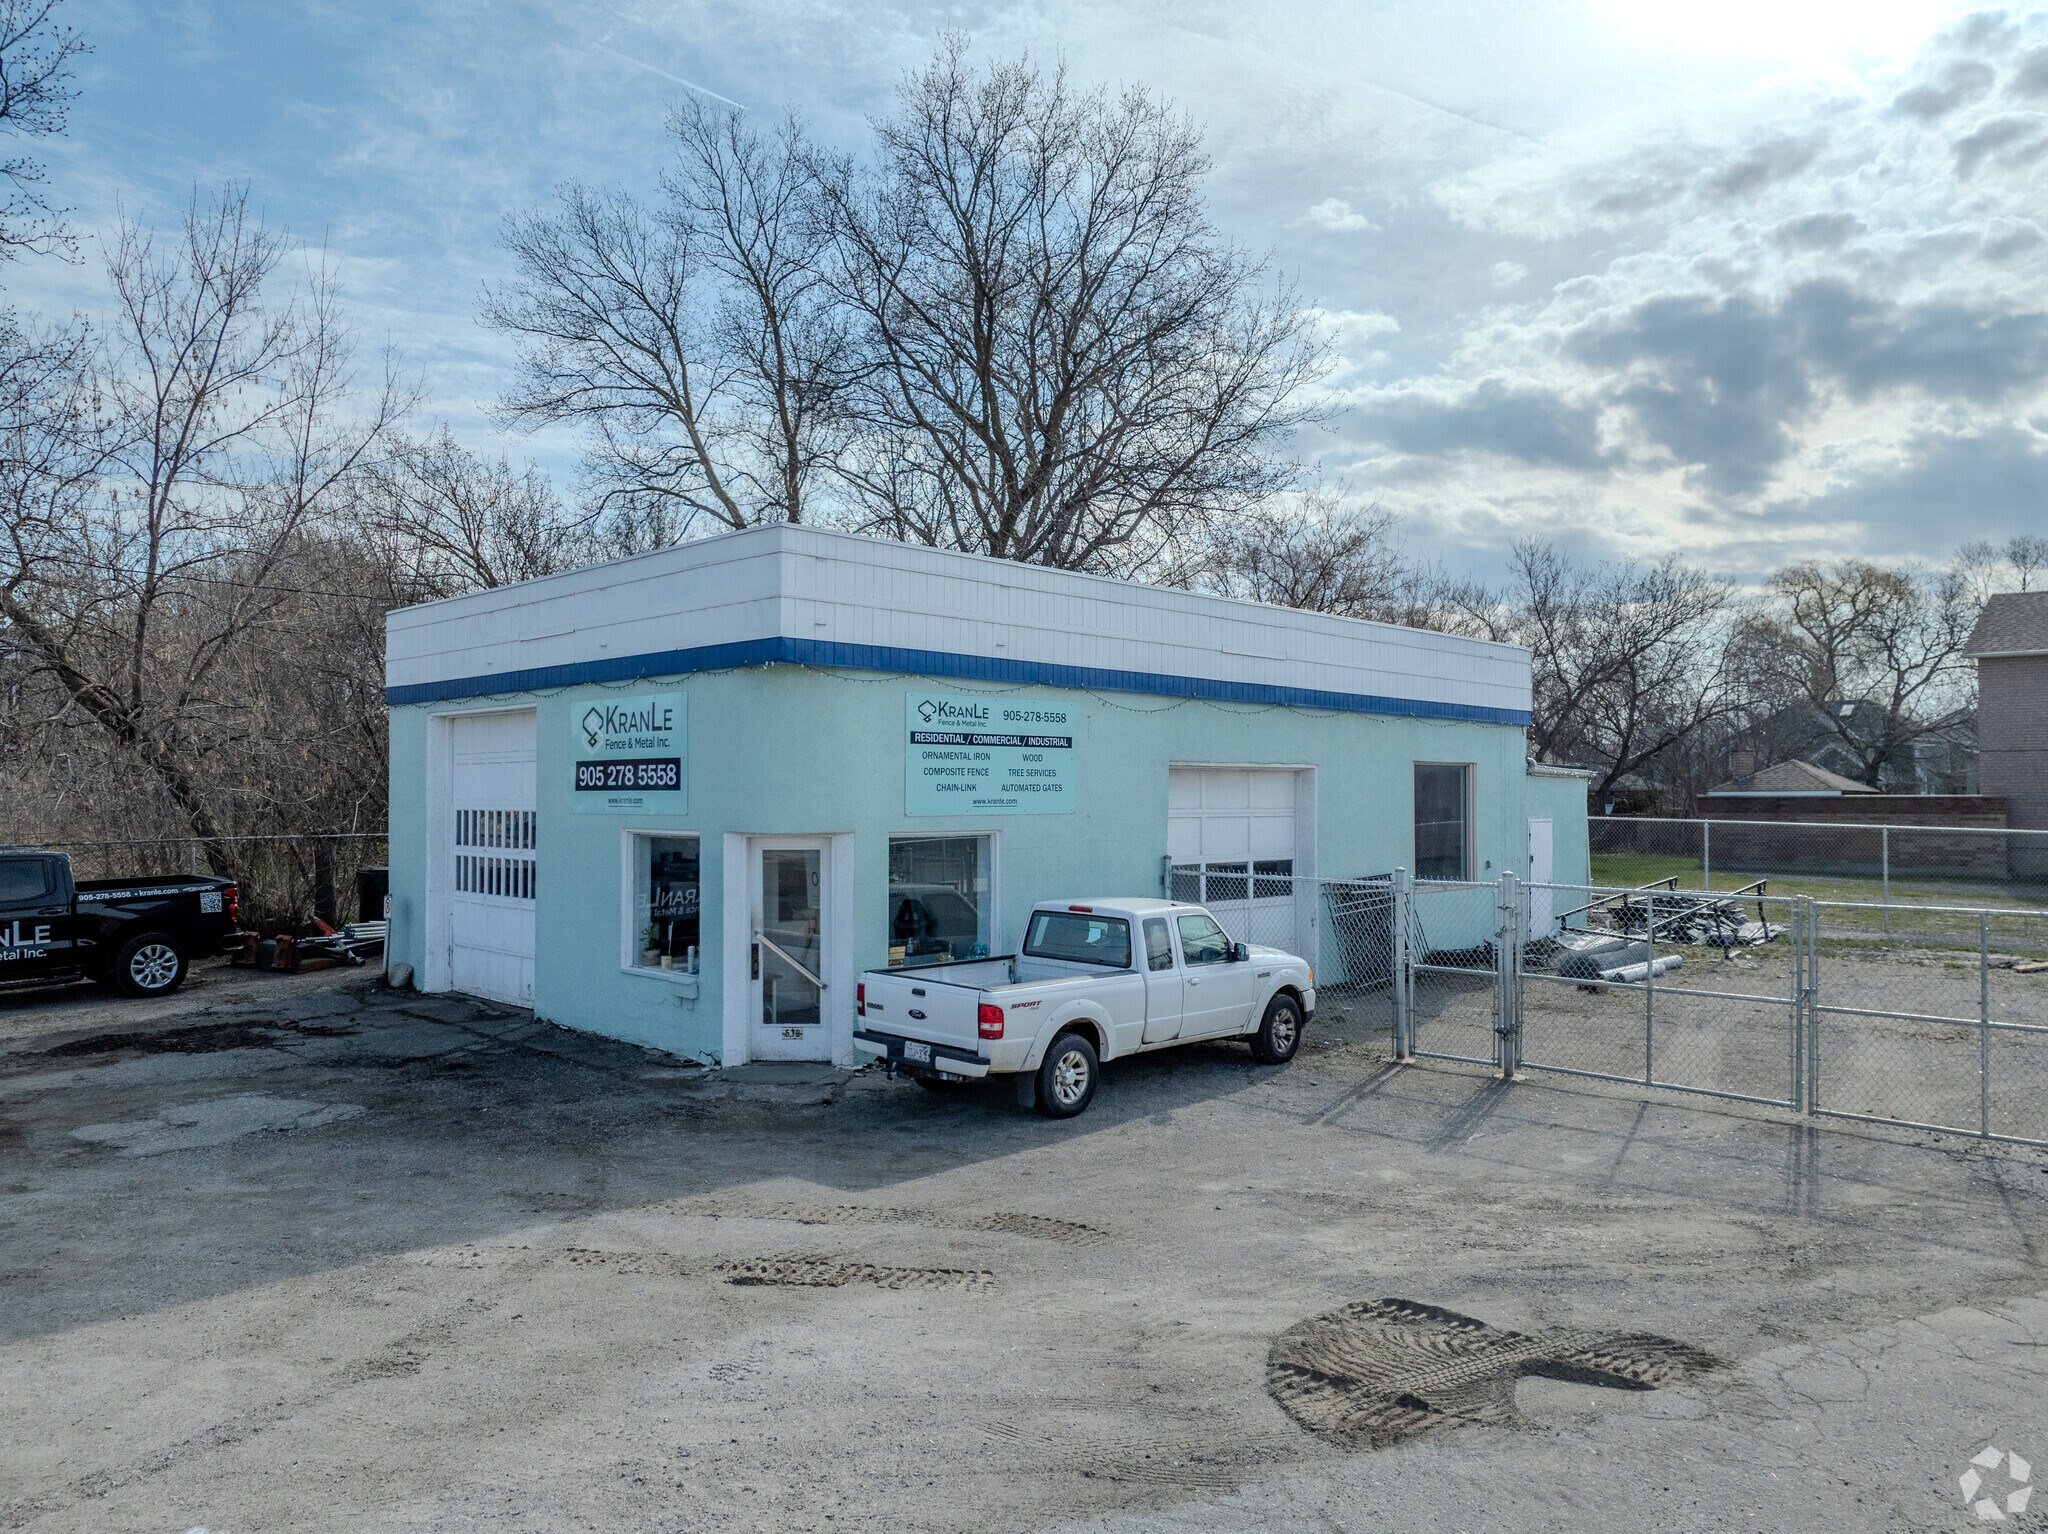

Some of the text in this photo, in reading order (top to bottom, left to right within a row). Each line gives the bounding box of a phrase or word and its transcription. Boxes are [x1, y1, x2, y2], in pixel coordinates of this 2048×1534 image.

[938, 701, 989, 720] KRANLE
[606, 702, 673, 734] KRANLE
[1003, 710, 1067, 723] 905-278-5558
[605, 736, 670, 750] Fence & Metal Inc.
[914, 732, 966, 744] RESIDENTIAL
[973, 734, 1022, 746] COMMERCIAL
[1028, 736, 1069, 747] INDUSTRIAL
[922, 751, 991, 761] ORNAMENTAL IRON
[1022, 754, 1043, 762] WOOD
[579, 763, 677, 787] 905 278 5558
[923, 768, 989, 776] COMPOSITE FENCE
[1008, 768, 1056, 777] TREE SERVICES
[936, 783, 977, 792] CHAIN-LINK
[1001, 784, 1063, 792] AUTOMATED GATES
[608, 796, 644, 805] www.kranle.com
[78, 891, 131, 902] 905-278-5558
[138, 888, 179, 897] kranle.com
[24, 948, 48, 959] Inc.
[1010, 1000, 1043, 1009] SPORT
